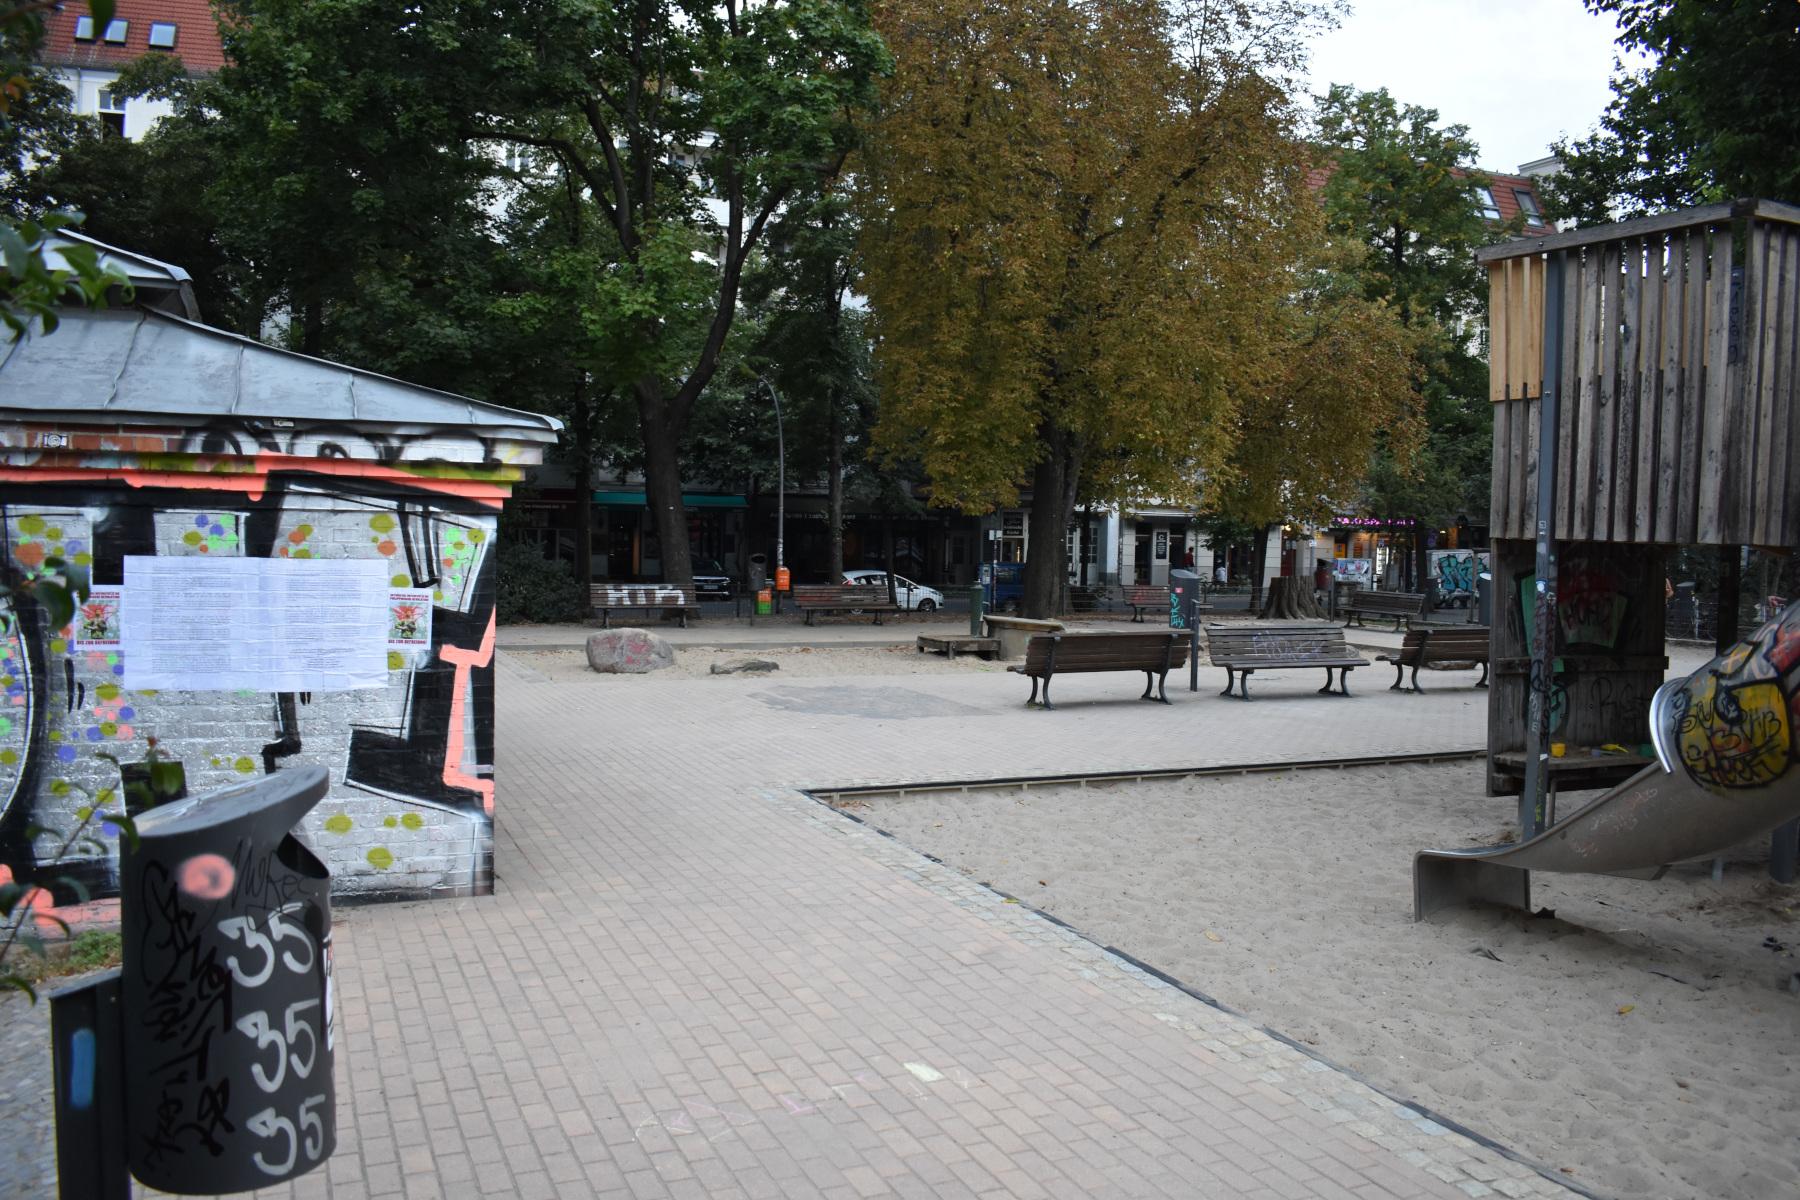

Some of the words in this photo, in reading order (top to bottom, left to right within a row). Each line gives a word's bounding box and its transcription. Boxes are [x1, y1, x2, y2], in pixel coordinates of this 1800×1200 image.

[218, 902, 314, 988] 35
[237, 998, 320, 1093] 35
[247, 1094, 325, 1176] 35
